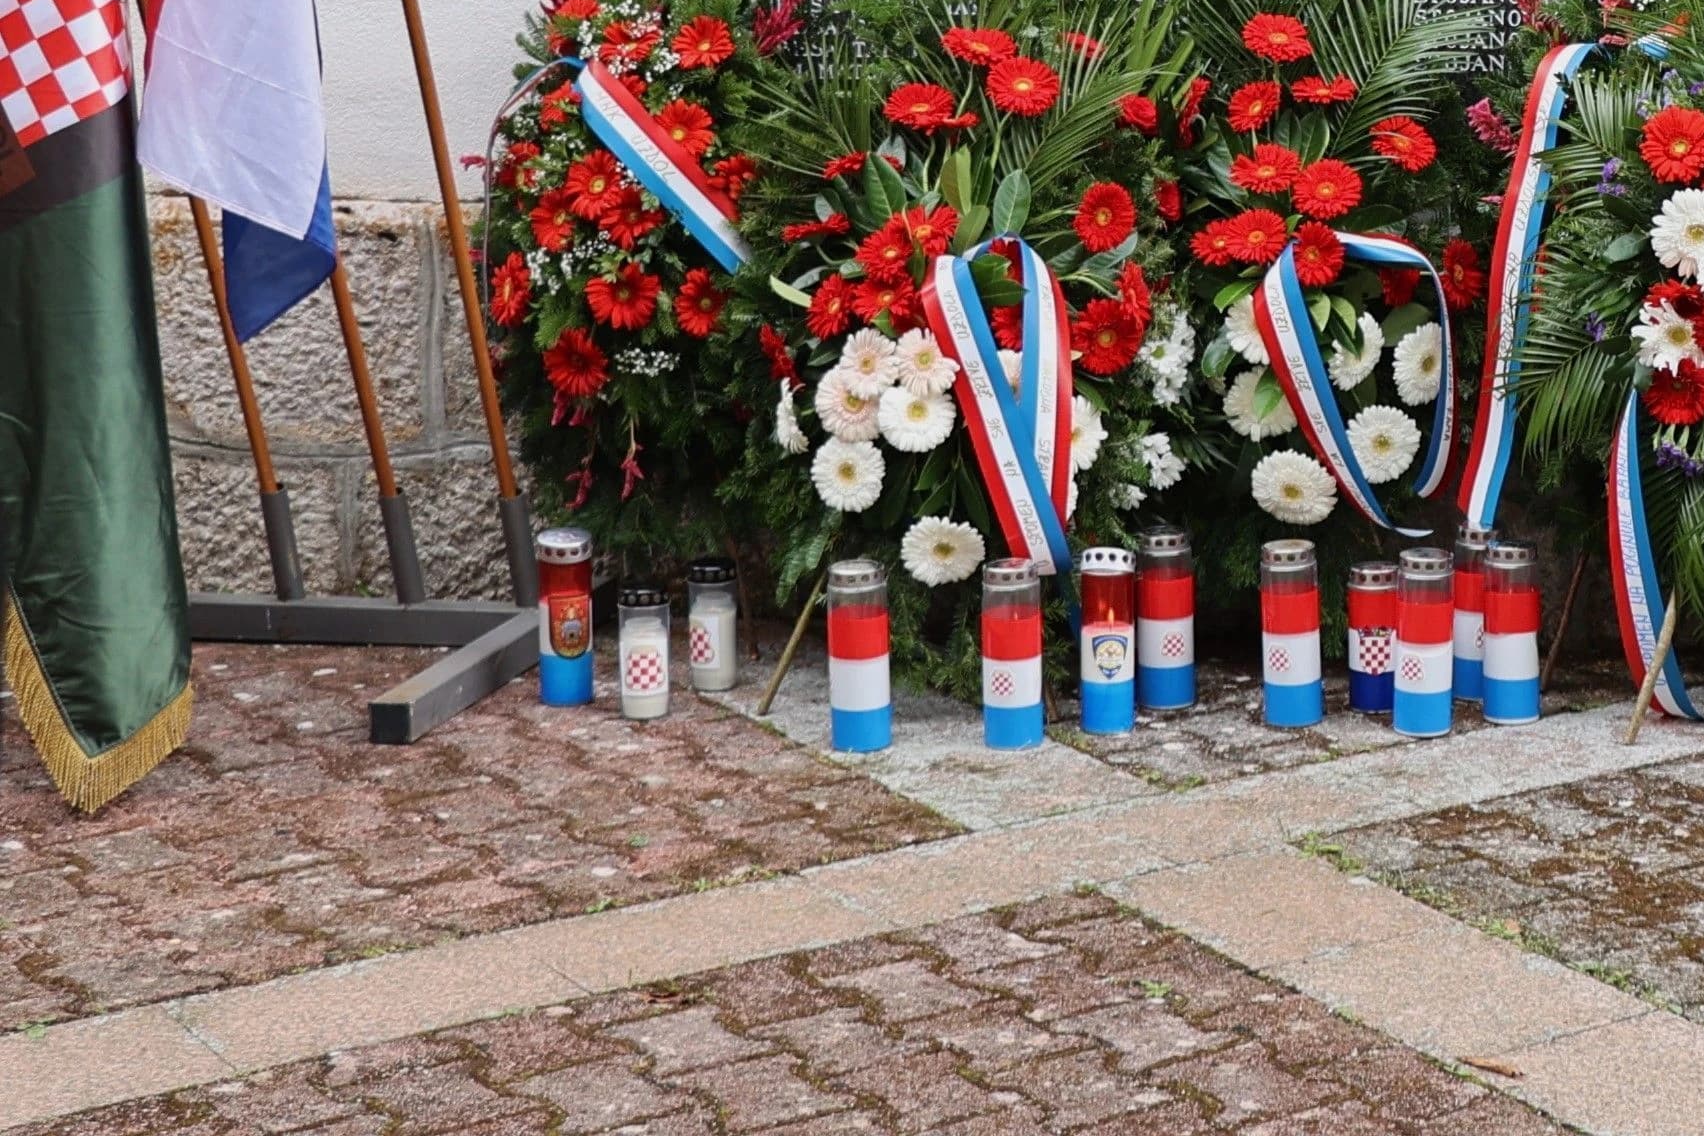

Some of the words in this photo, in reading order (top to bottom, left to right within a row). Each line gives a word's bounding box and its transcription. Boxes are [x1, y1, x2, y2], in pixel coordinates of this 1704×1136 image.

[944, 289, 970, 340] UZDOLA
[988, 417, 1004, 439] SVE
[1016, 498, 1044, 546] SPOMEN
